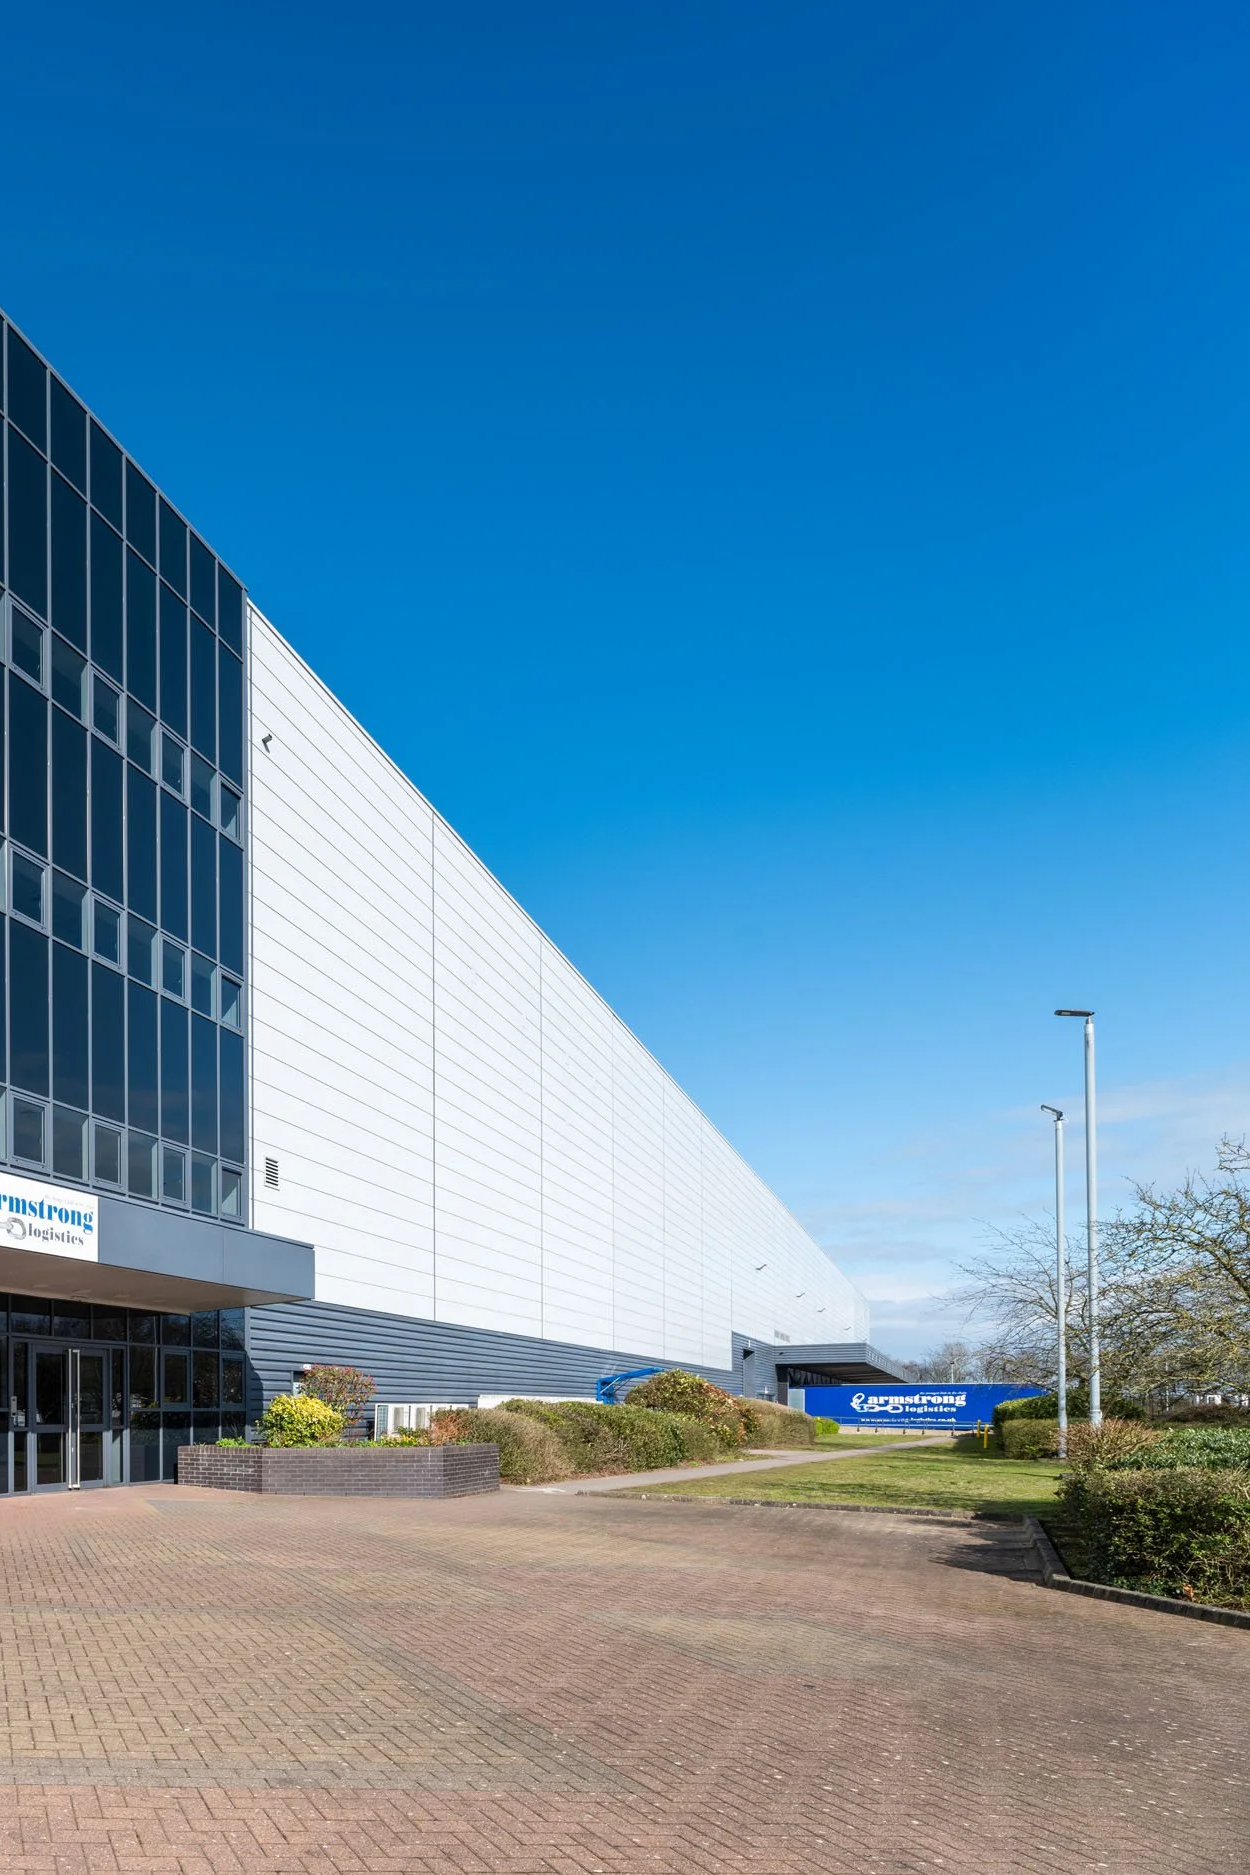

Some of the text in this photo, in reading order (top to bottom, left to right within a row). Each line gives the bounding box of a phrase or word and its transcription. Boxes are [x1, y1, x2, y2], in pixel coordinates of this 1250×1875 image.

[28, 1223, 85, 1246] logistics
[867, 1394, 966, 1406] armstrong
[905, 1405, 956, 1413] logistics
